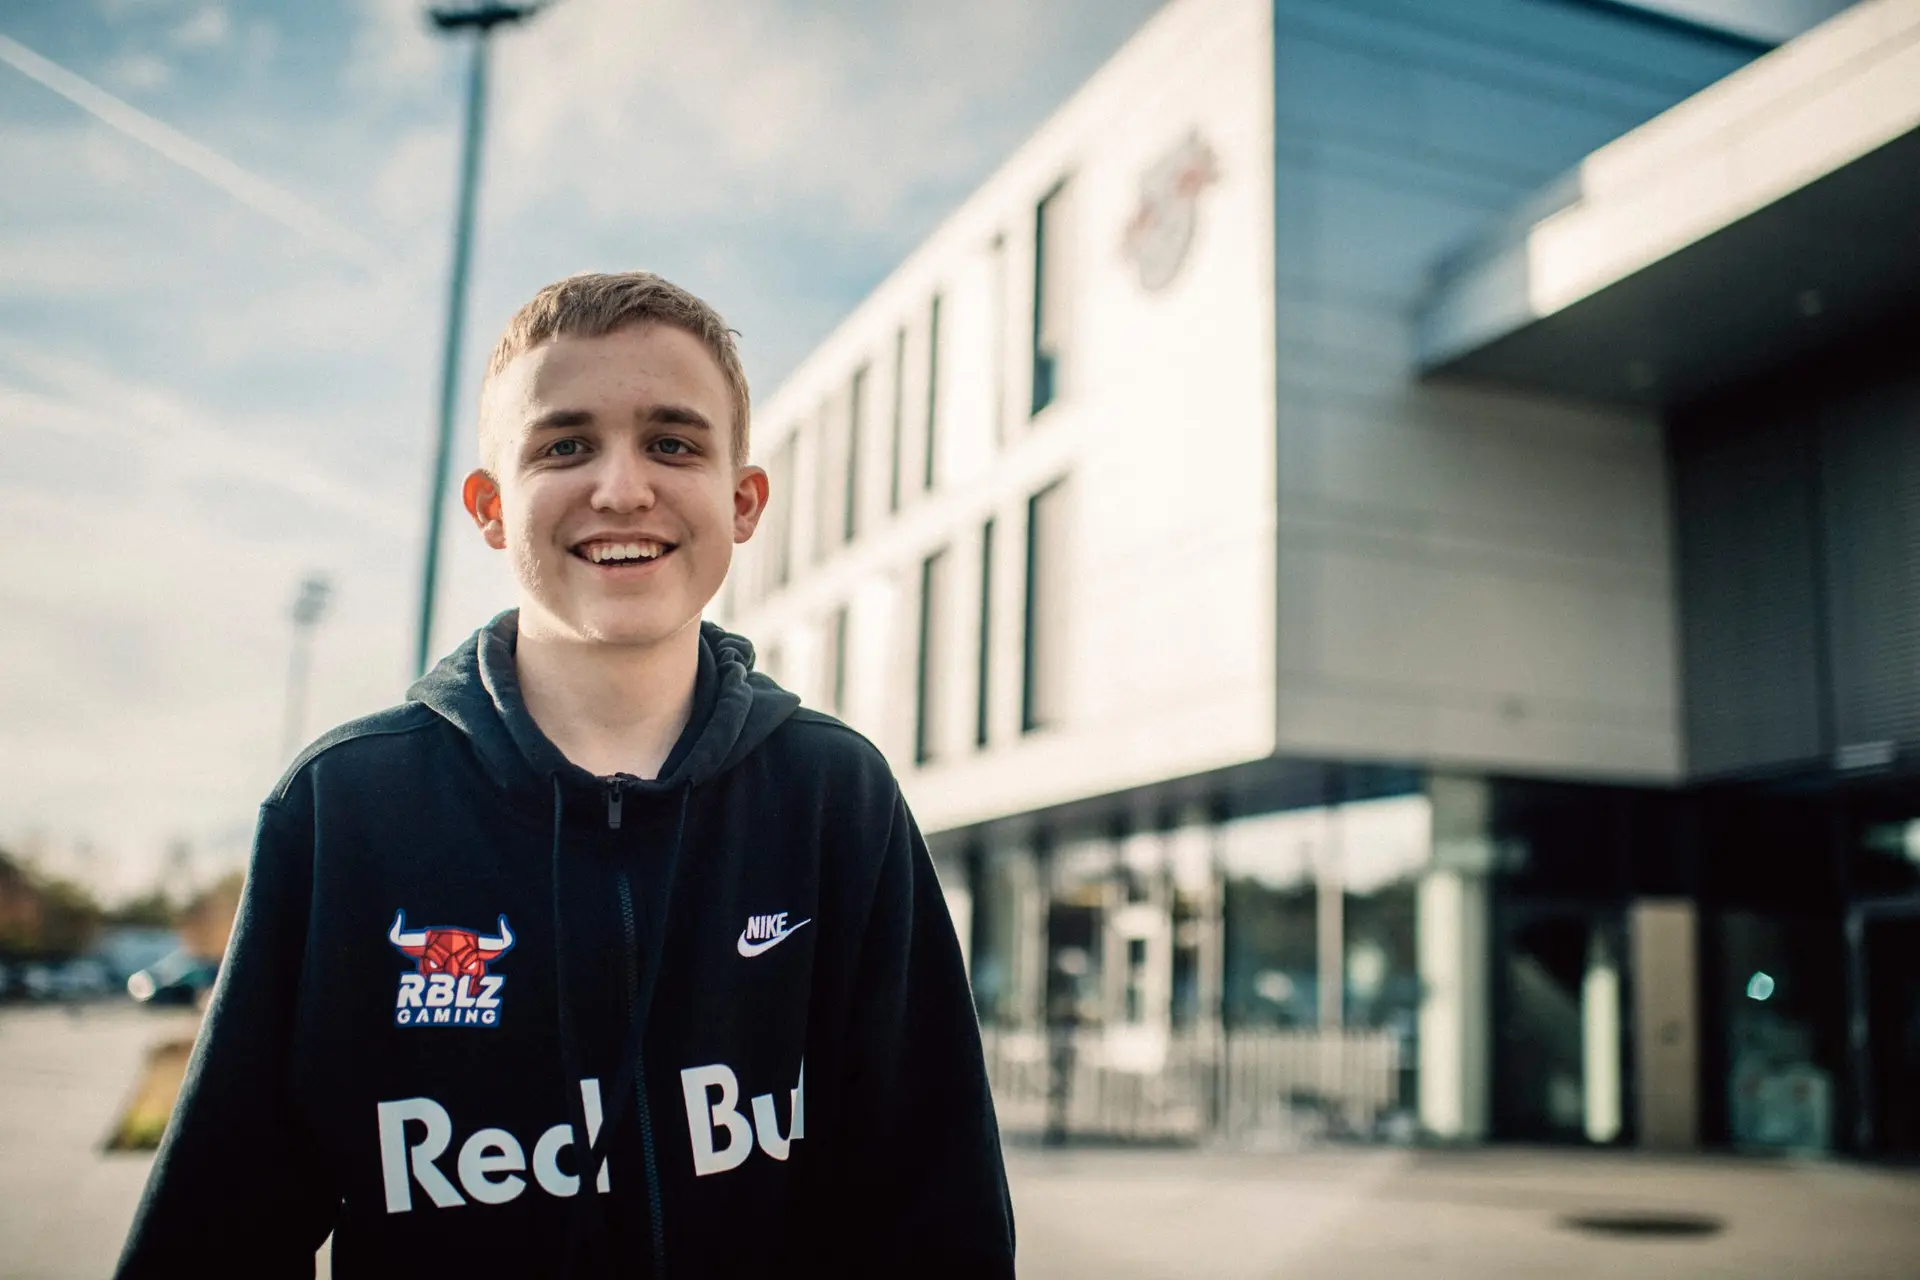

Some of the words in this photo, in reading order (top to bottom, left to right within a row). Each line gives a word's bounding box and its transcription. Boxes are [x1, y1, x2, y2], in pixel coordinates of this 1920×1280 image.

[746, 911, 789, 940] NIKE
[396, 973, 504, 1009] RBLZ
[397, 1007, 496, 1025] GAMING
[377, 1077, 611, 1214] Red
